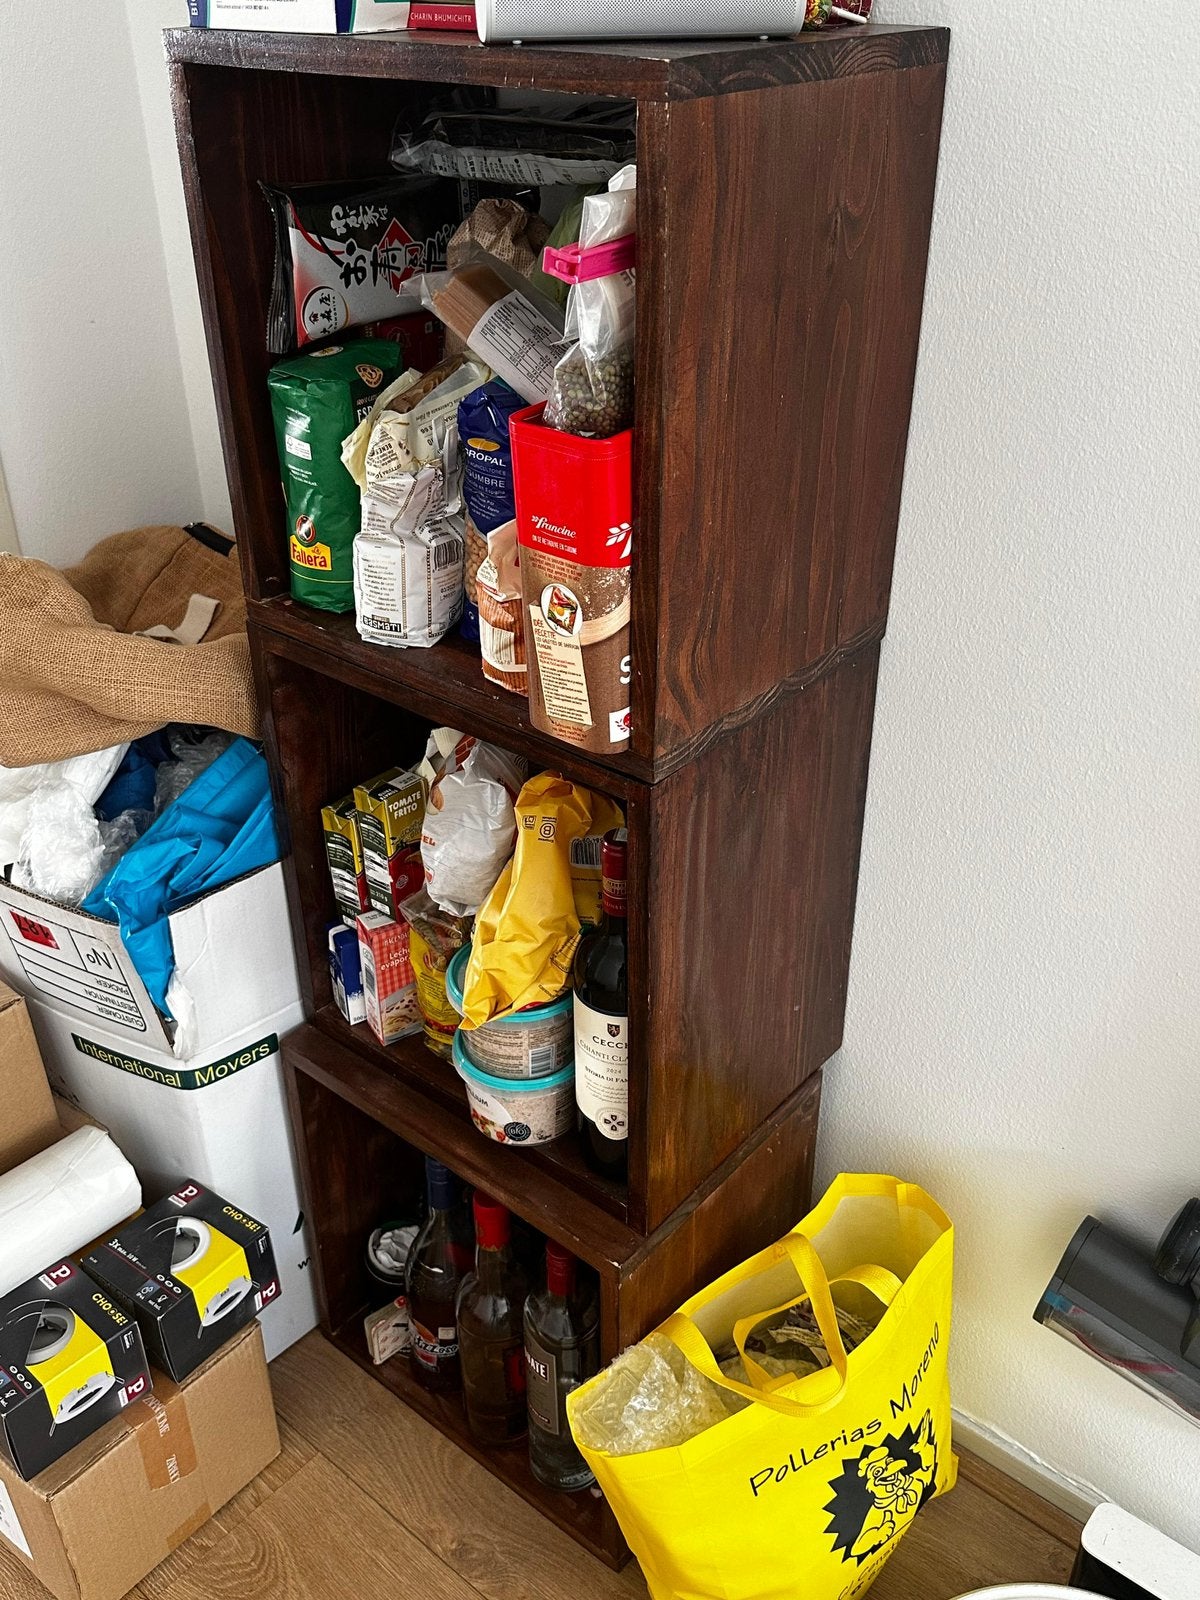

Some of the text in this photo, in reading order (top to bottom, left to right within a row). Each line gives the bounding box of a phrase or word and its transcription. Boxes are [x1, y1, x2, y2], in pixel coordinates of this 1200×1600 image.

[410, 12, 472, 23] CHARIN BHUMICHITR
[535, 516, 577, 539] francine
[291, 542, 328, 568] Fallera
[619, 654, 632, 685] S
[388, 790, 422, 813] TOMATE
[394, 802, 418, 821] FRITO
[86, 947, 113, 970] No
[95, 977, 130, 996] PACKER
[84, 988, 139, 1014] DESTINATION
[96, 1005, 144, 1028] CUSTOMER
[579, 1039, 610, 1061] CHIANTI
[79, 1037, 271, 1088] International Movers
[749, 1321, 939, 1497] Pollerias Moreno
